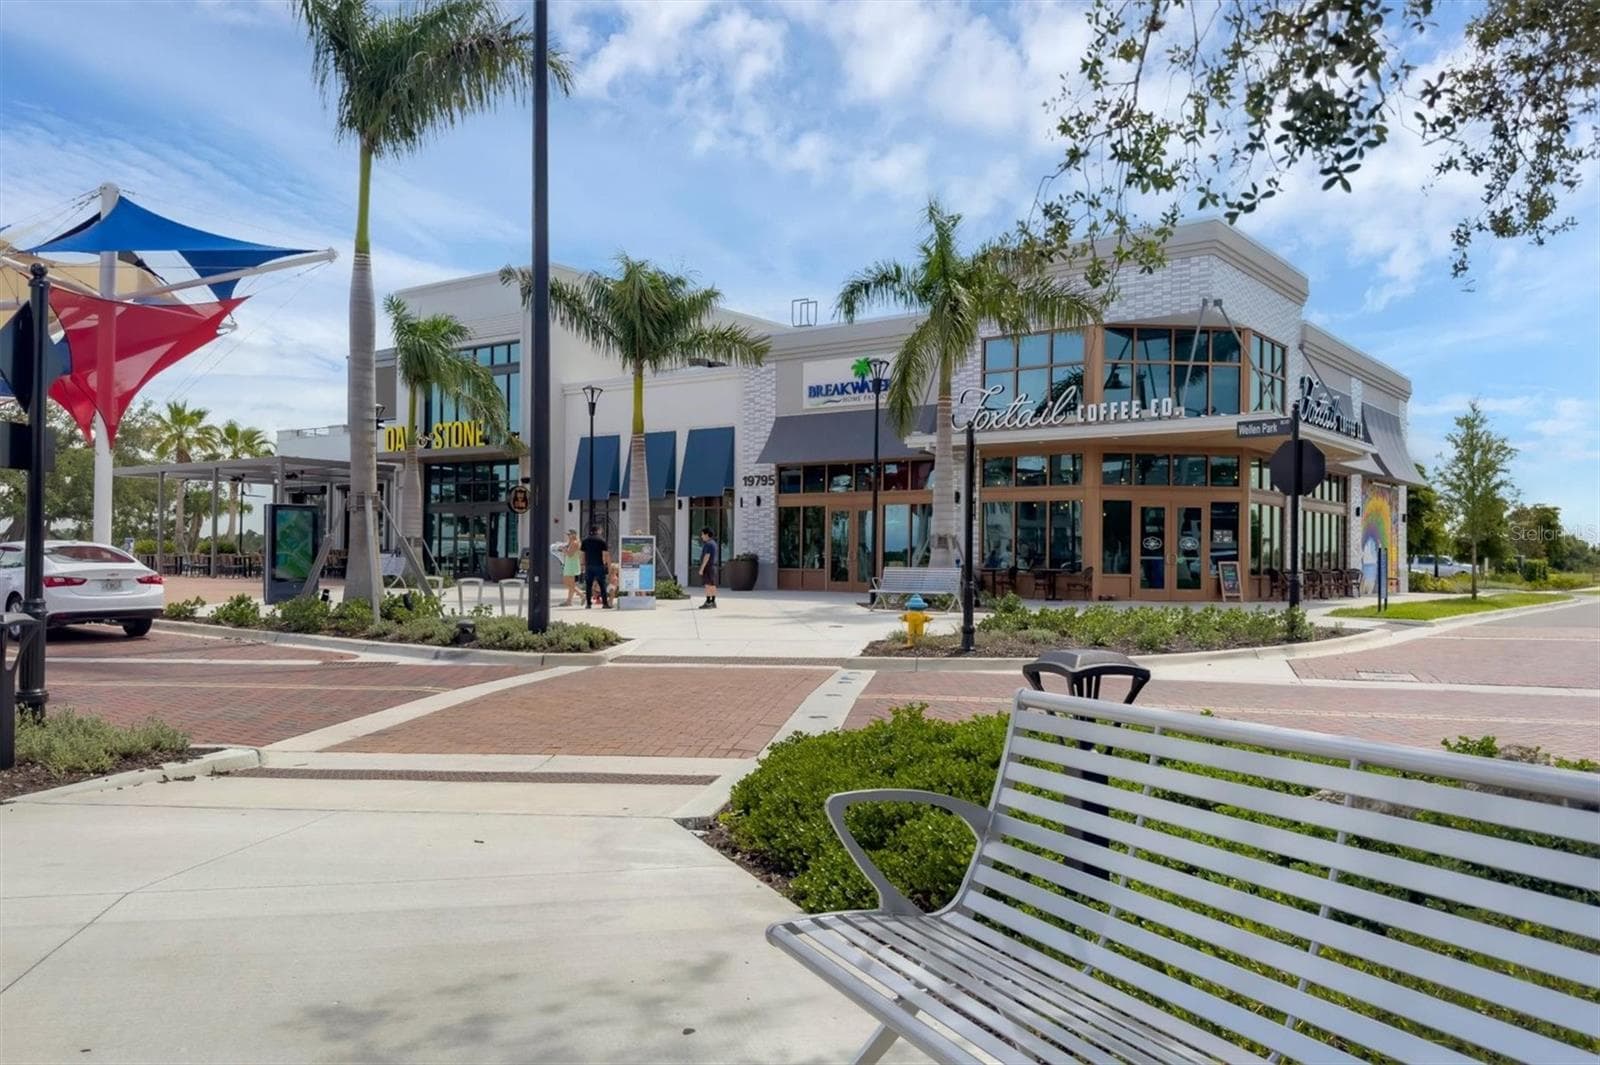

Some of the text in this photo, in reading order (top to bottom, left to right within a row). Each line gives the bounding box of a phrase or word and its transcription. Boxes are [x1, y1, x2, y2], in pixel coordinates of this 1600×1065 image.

[952, 384, 1180, 432] Foxtail COFFEE CO.
[385, 426, 409, 452] OA
[432, 419, 486, 449] STONE
[1239, 424, 1261, 436] Wellen
[1262, 422, 1278, 434] Park
[743, 475, 776, 487] 19795
